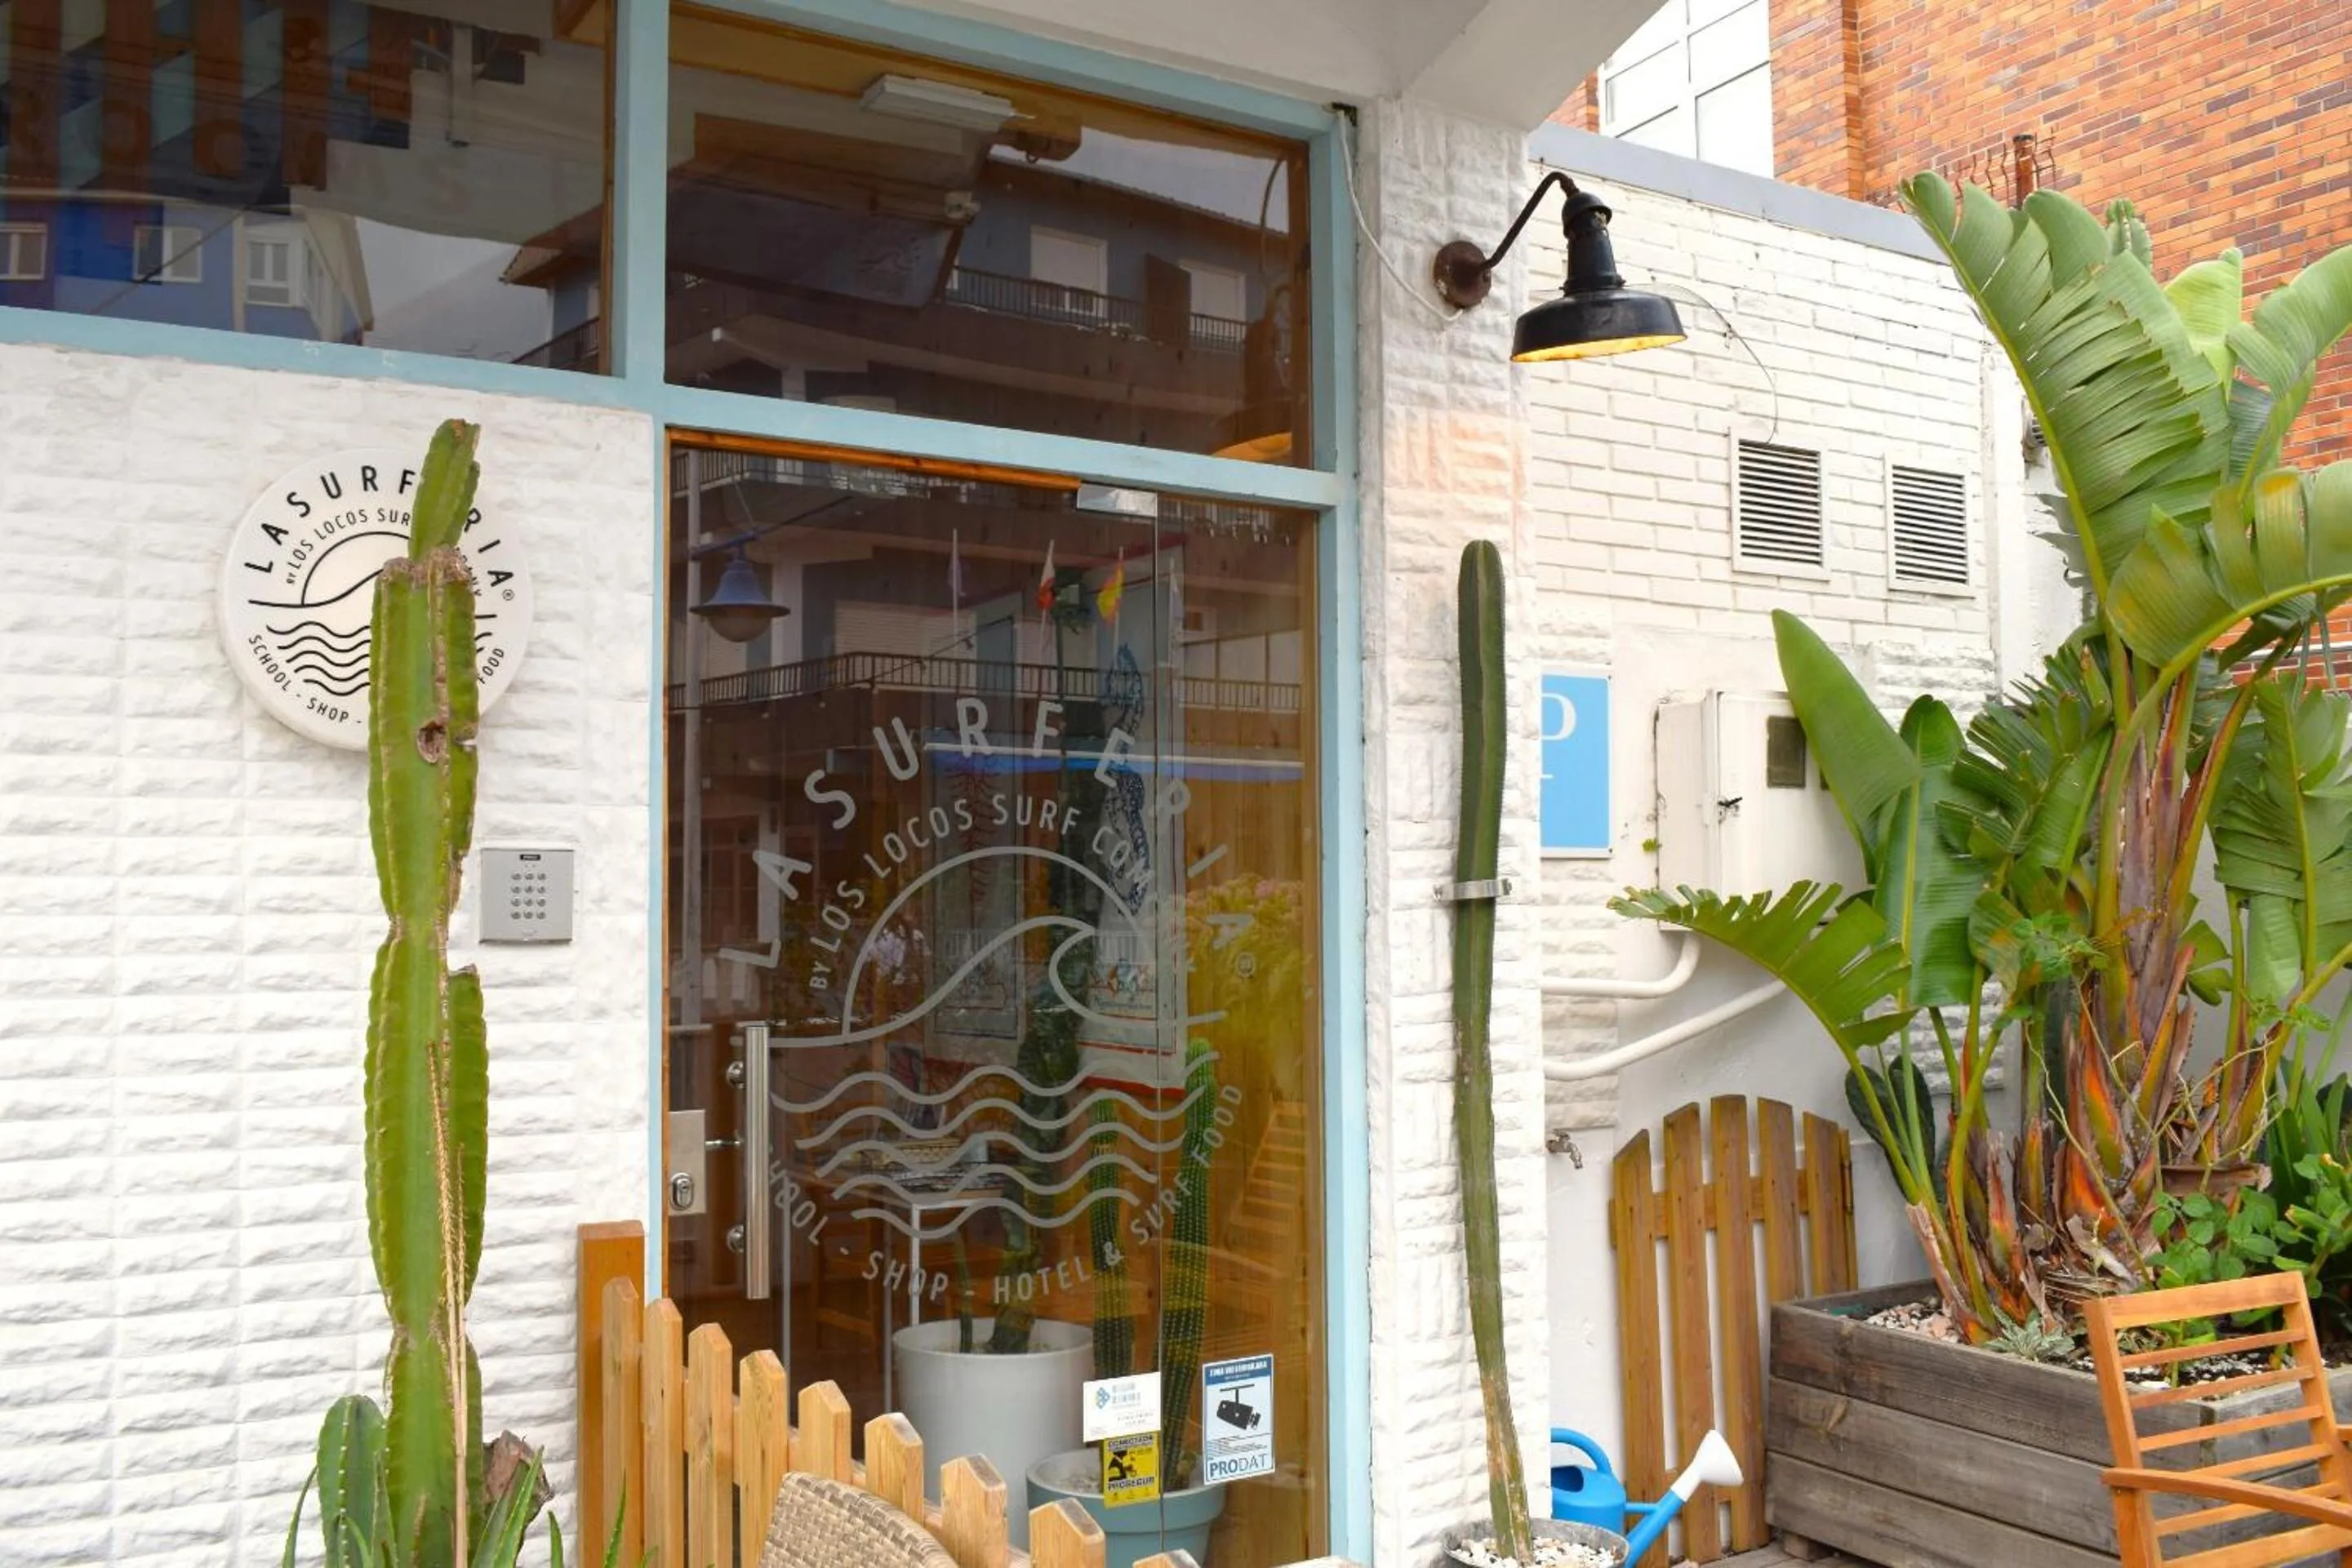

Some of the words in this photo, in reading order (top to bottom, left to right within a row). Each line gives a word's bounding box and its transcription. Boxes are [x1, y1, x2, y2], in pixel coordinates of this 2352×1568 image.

[287, 465, 514, 588] SURFRIA
[287, 539, 314, 570] LOS
[313, 509, 368, 540] LOCOS
[377, 507, 411, 526] SUR
[247, 634, 291, 692] SCHOOL
[306, 697, 350, 724] SHOP
[864, 797, 973, 879] LOCOS
[991, 793, 1082, 834] SURF
[814, 881, 866, 955] LOS
[809, 963, 831, 991] BY
[769, 1146, 829, 1246] HOOL
[861, 1250, 949, 1302] SHOP
[994, 1255, 1092, 1305] HOTEL
[1104, 1241, 1123, 1268] &
[1131, 1176, 1193, 1245] SURF
[1191, 1085, 1243, 1168] FOOD
[1209, 1453, 1269, 1478] PRODAT
